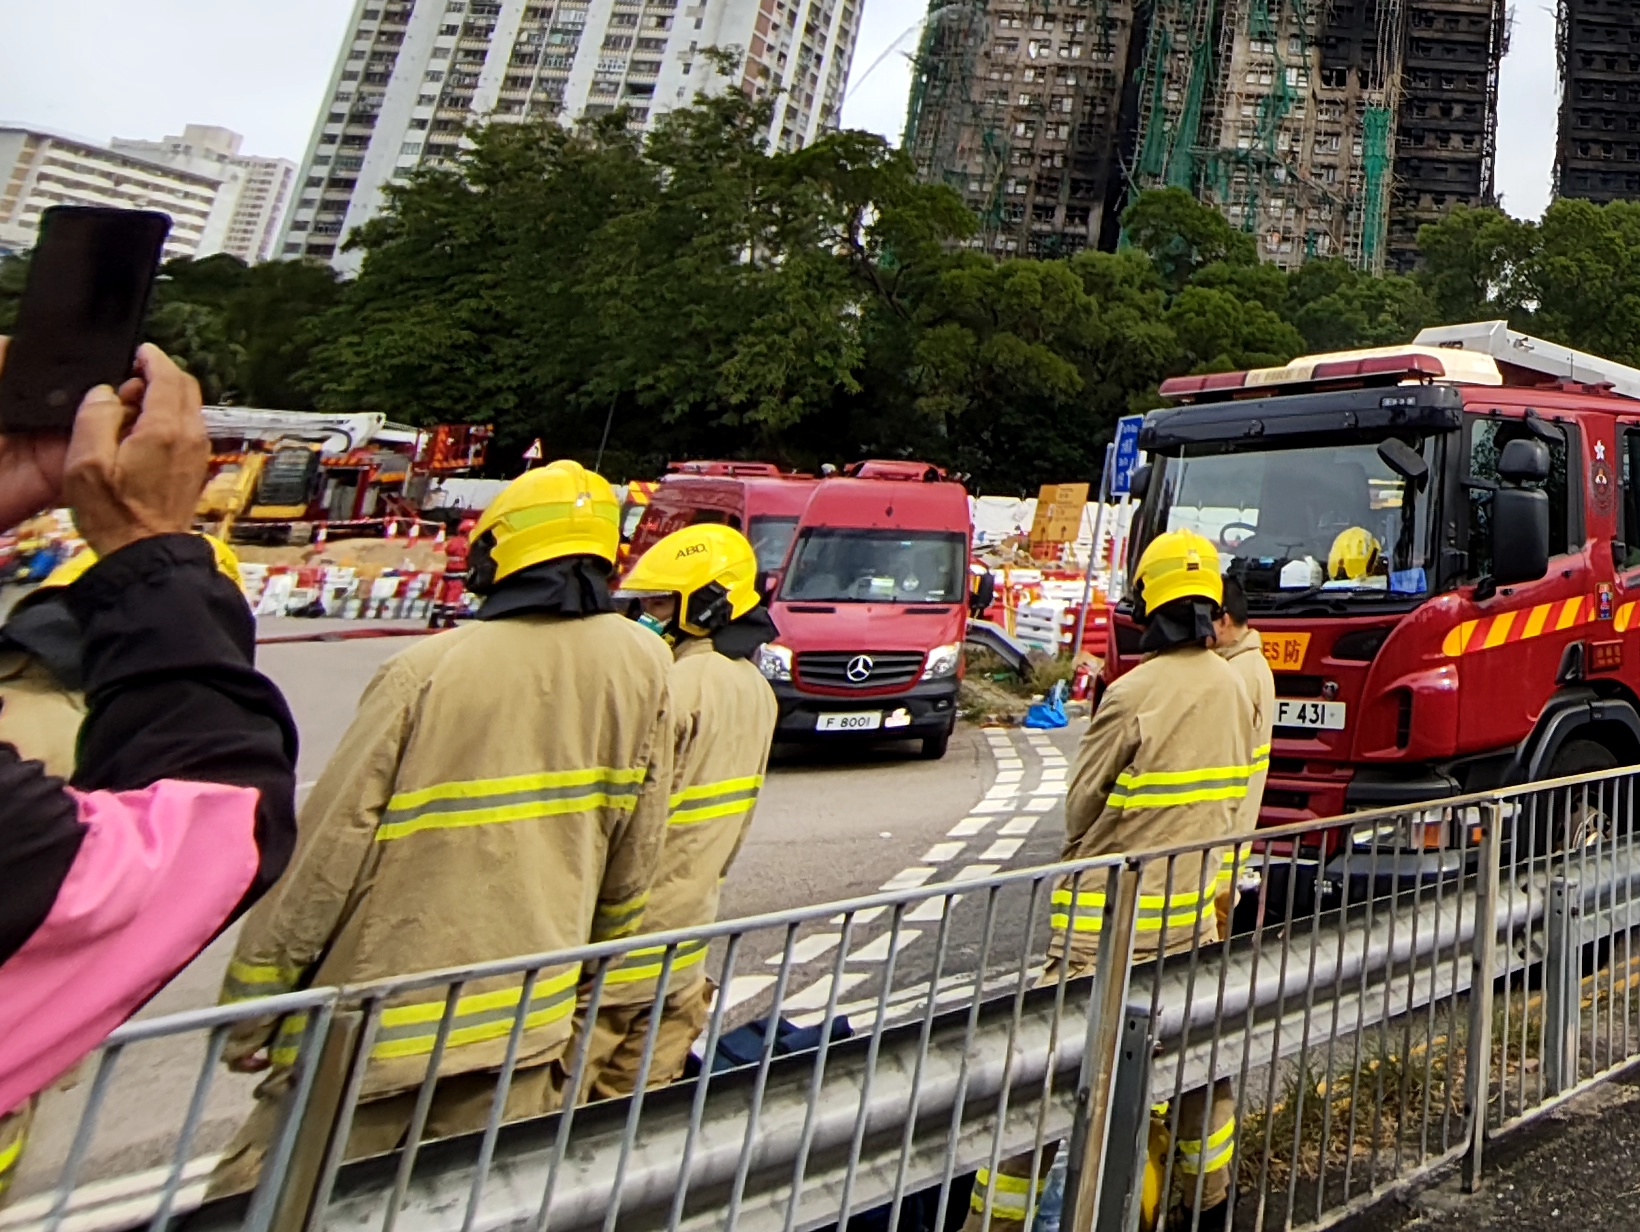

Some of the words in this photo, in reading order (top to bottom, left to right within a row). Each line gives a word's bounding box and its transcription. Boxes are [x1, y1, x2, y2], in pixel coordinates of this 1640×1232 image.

[1263, 641, 1279, 661] ES
[1283, 639, 1301, 664] 防
[826, 717, 836, 728] F
[840, 716, 871, 727] 8001
[1278, 702, 1290, 723] F
[1297, 703, 1326, 725] 431
